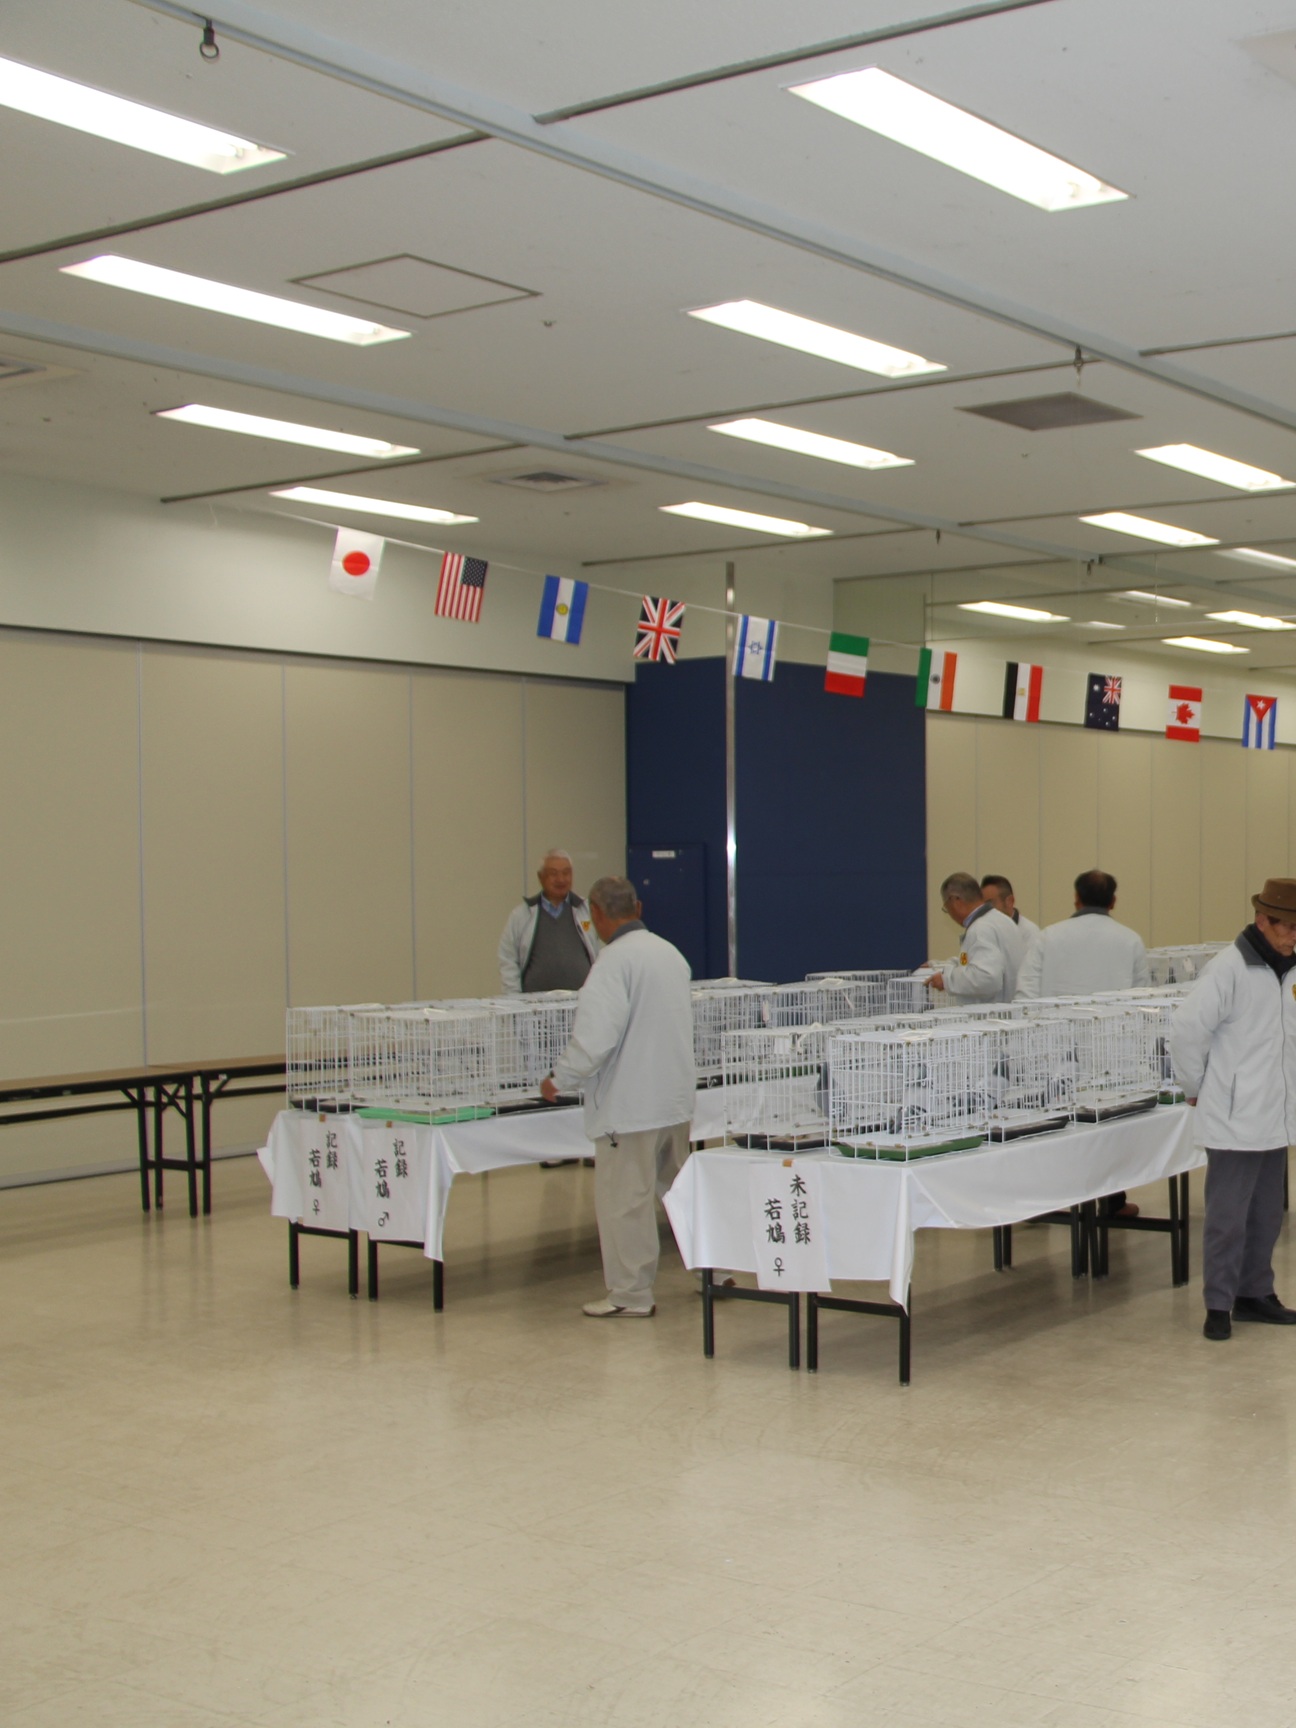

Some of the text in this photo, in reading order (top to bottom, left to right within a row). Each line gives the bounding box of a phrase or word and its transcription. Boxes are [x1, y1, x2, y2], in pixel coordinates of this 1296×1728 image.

[326, 1131, 338, 1170] 記録
[393, 1138, 408, 1178] 記録
[764, 1198, 785, 1244] 若鳩
[790, 1174, 811, 1245] 未記録
